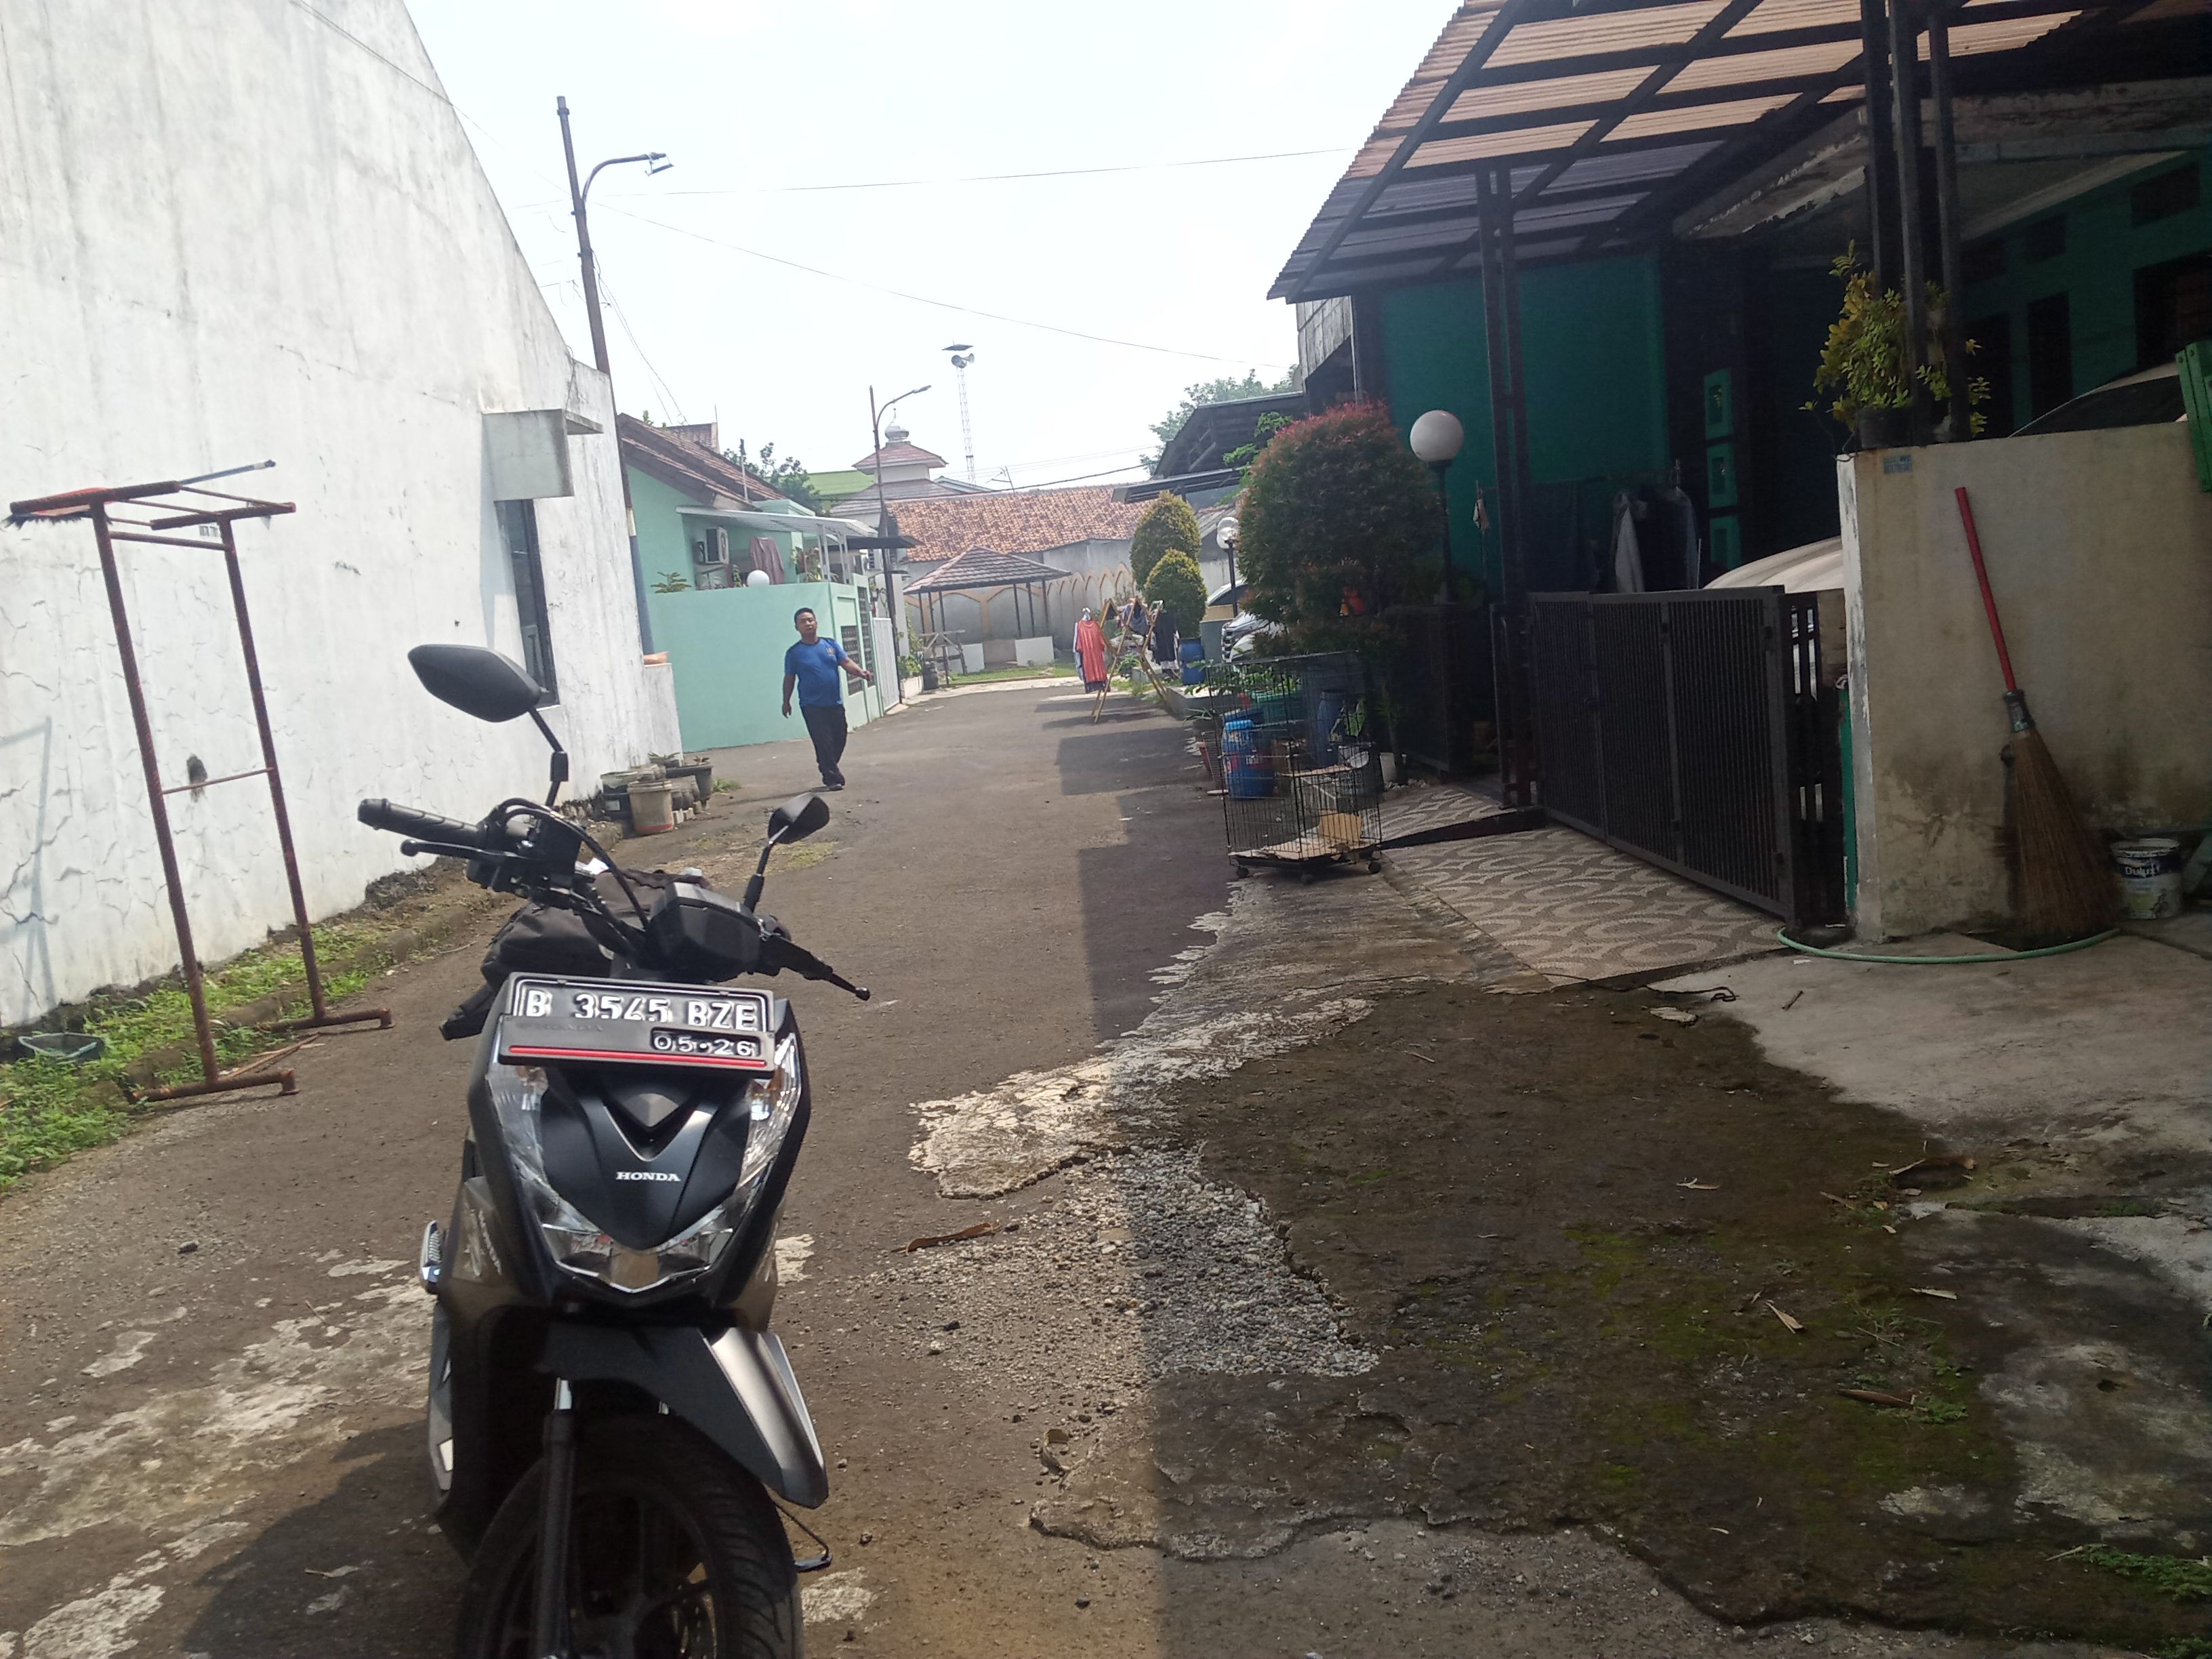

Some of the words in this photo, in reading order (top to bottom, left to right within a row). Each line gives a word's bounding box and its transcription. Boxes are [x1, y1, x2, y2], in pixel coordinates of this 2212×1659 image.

[526, 989, 548, 1017] B
[575, 993, 668, 1023] 3545
[688, 1001, 755, 1031] BZE
[615, 1172, 681, 1182] HONDA
